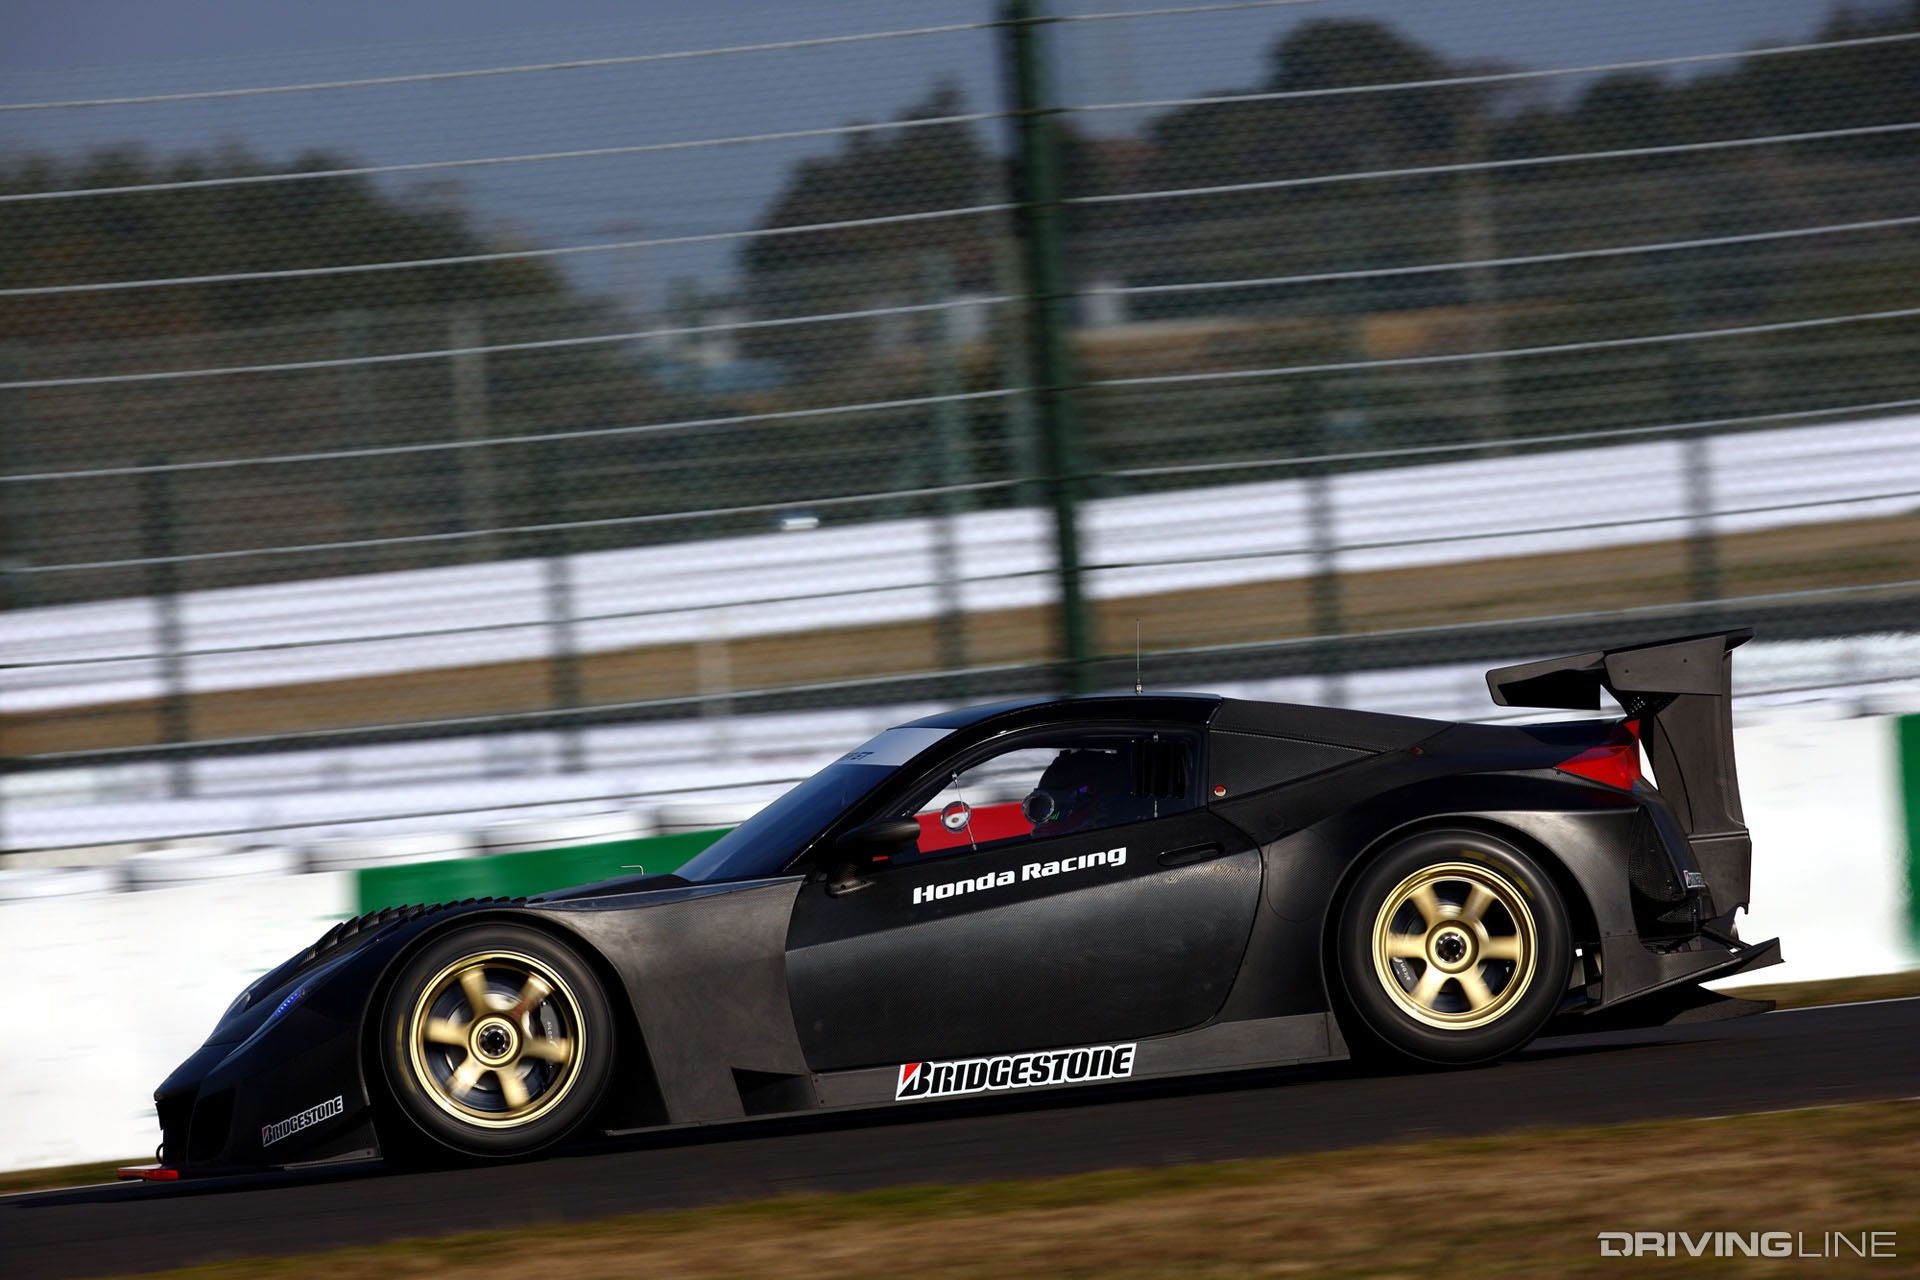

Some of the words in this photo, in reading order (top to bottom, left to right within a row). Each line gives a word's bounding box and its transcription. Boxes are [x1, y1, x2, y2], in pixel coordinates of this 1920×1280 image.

[913, 870, 1016, 905] Honda
[1021, 846, 1127, 882] Racing
[897, 1045, 1135, 1099] BRIDGESTONE
[262, 1096, 343, 1146] BRIDGESTONE
